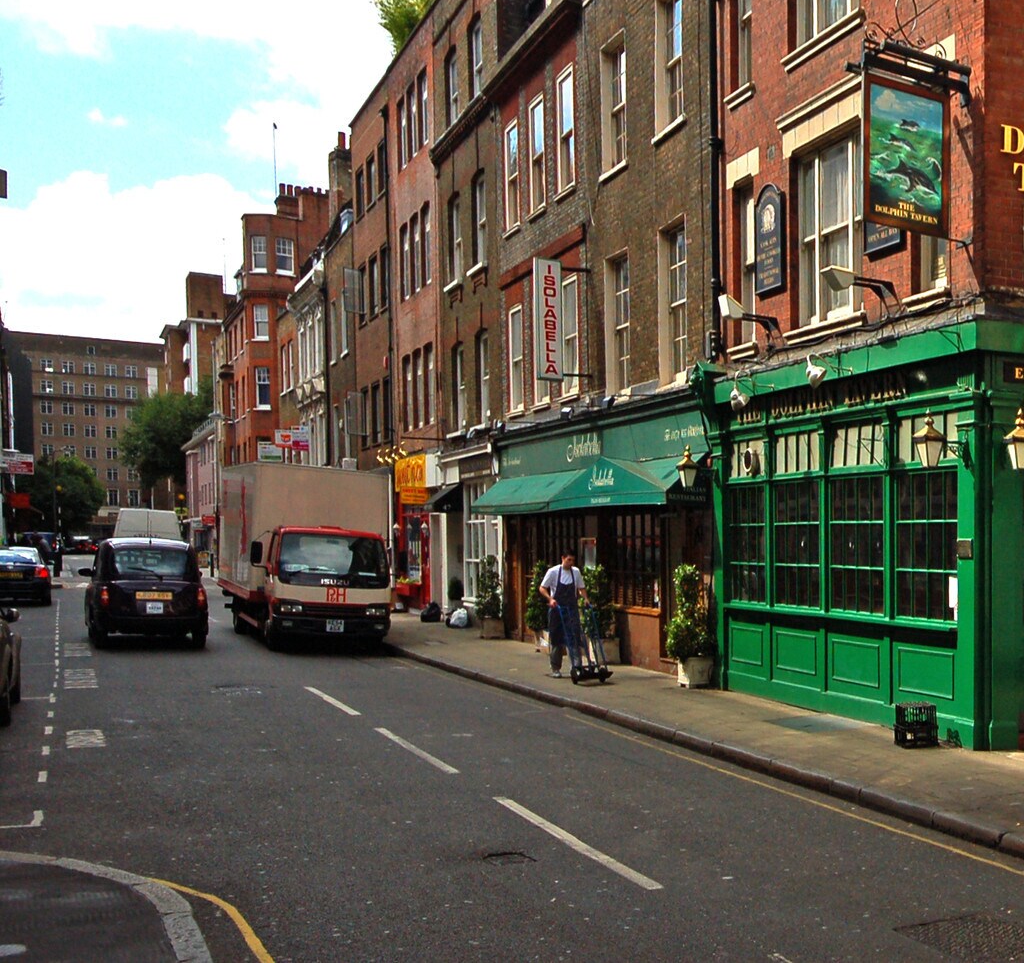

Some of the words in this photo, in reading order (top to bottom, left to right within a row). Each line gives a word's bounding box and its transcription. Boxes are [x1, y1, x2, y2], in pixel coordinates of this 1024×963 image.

[875, 204, 908, 218] DOLPHIN
[911, 212, 938, 224] TAVERN
[898, 201, 915, 212] THE
[543, 264, 558, 375] ISOLABELLA
